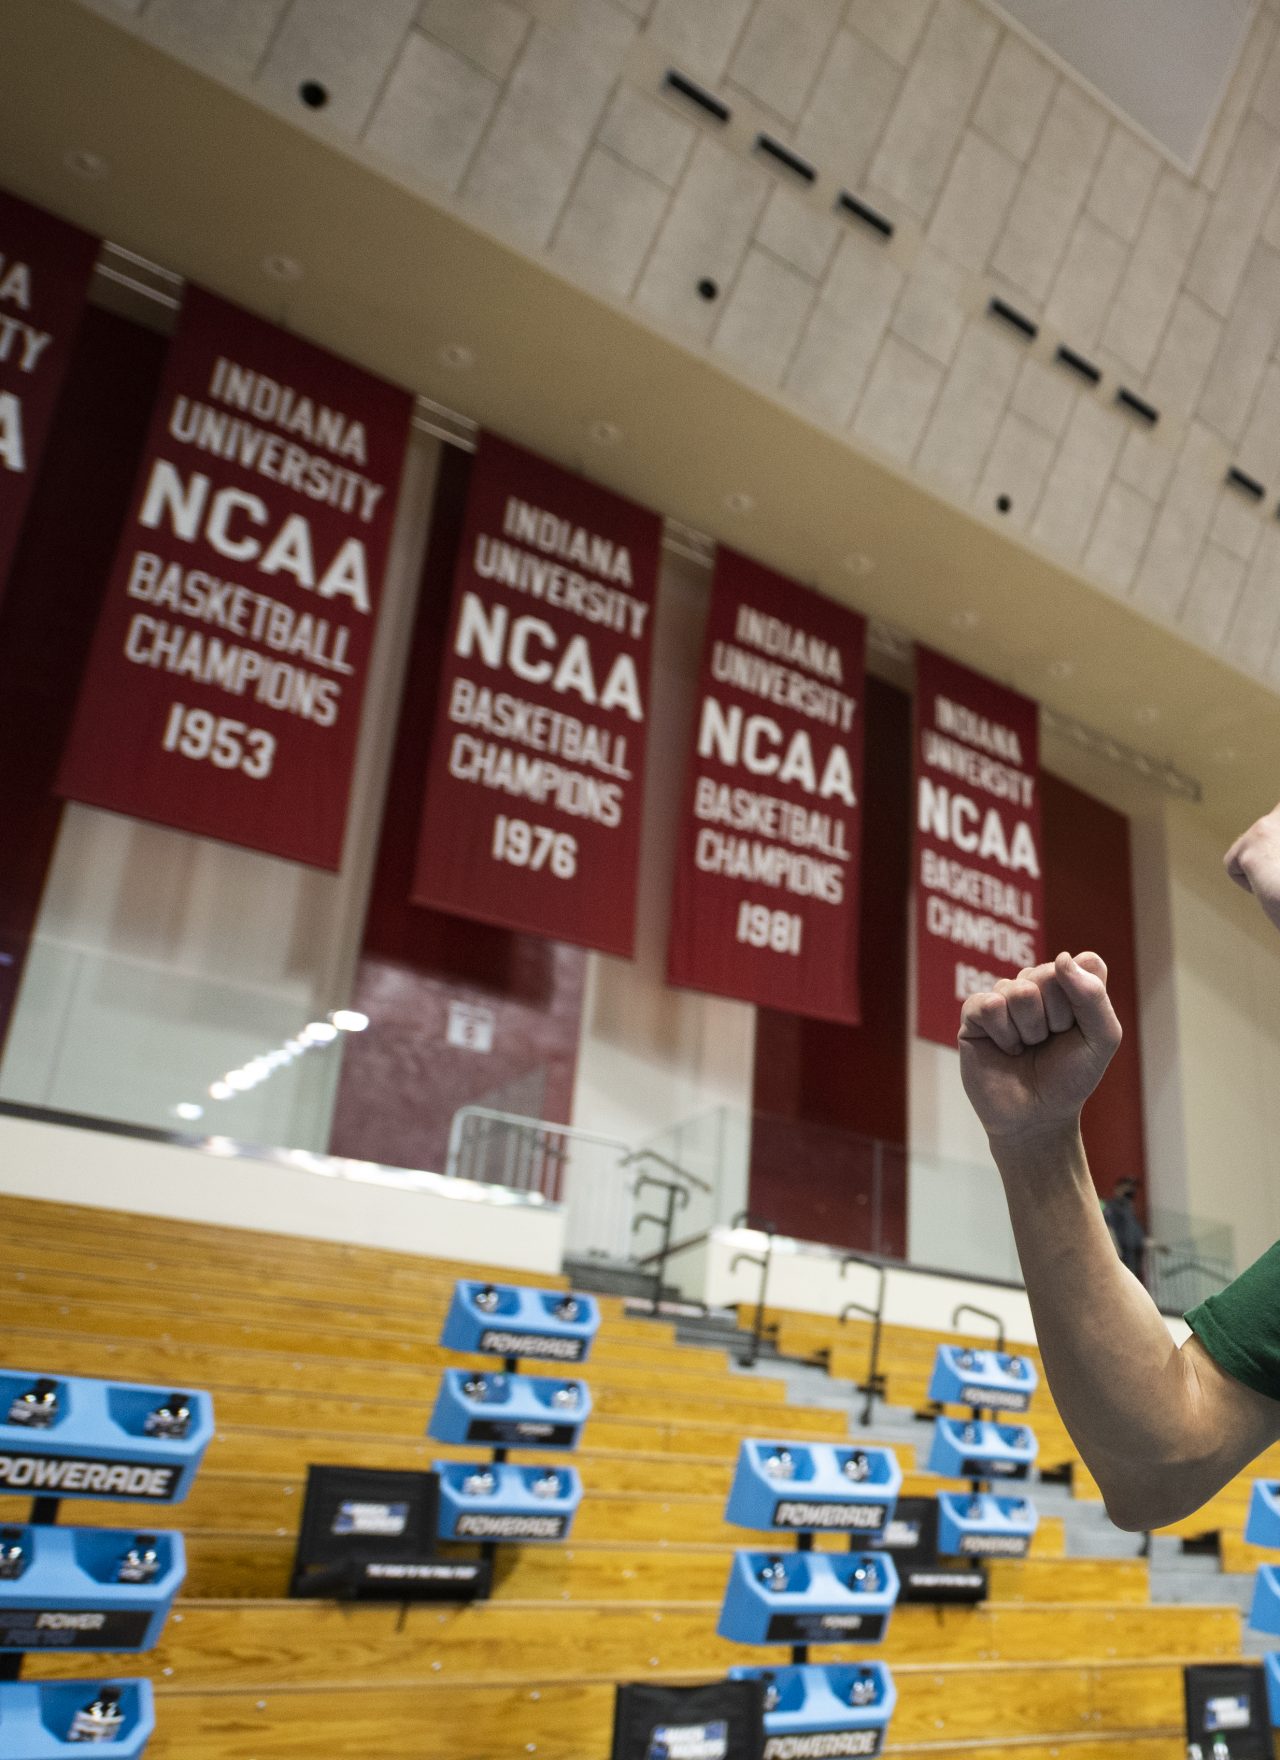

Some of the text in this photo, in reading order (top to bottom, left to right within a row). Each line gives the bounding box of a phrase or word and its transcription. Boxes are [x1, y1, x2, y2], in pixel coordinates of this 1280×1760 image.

[208, 355, 367, 467] INDIANA
[169, 394, 384, 523] UNIVERSITY
[139, 456, 371, 615] NCAA
[503, 495, 634, 588] INDIANA
[126, 550, 355, 676] BASKETBALL
[474, 532, 650, 640] UNIVERSITY
[124, 612, 343, 728] CHAMPIONS
[454, 591, 645, 722] NCAA
[711, 640, 857, 733] UNIVERSITY
[735, 603, 844, 685] INDIANA
[161, 702, 277, 780] 1953
[448, 676, 633, 782] BASKETBALL
[697, 695, 857, 807] NCAA
[921, 729, 1036, 808] UNIVERSITY
[934, 694, 1022, 766] INDIANA
[448, 733, 624, 828] CHAMPIONS
[693, 775, 851, 862] BASKETBALL
[491, 813, 579, 879] 1976
[694, 827, 844, 905] CHAMPIONS
[918, 776, 1041, 879] NCAA
[736, 899, 803, 955] 1981
[919, 849, 1040, 930] BASKETBALL
[926, 895, 1036, 969] CHAMPIONS
